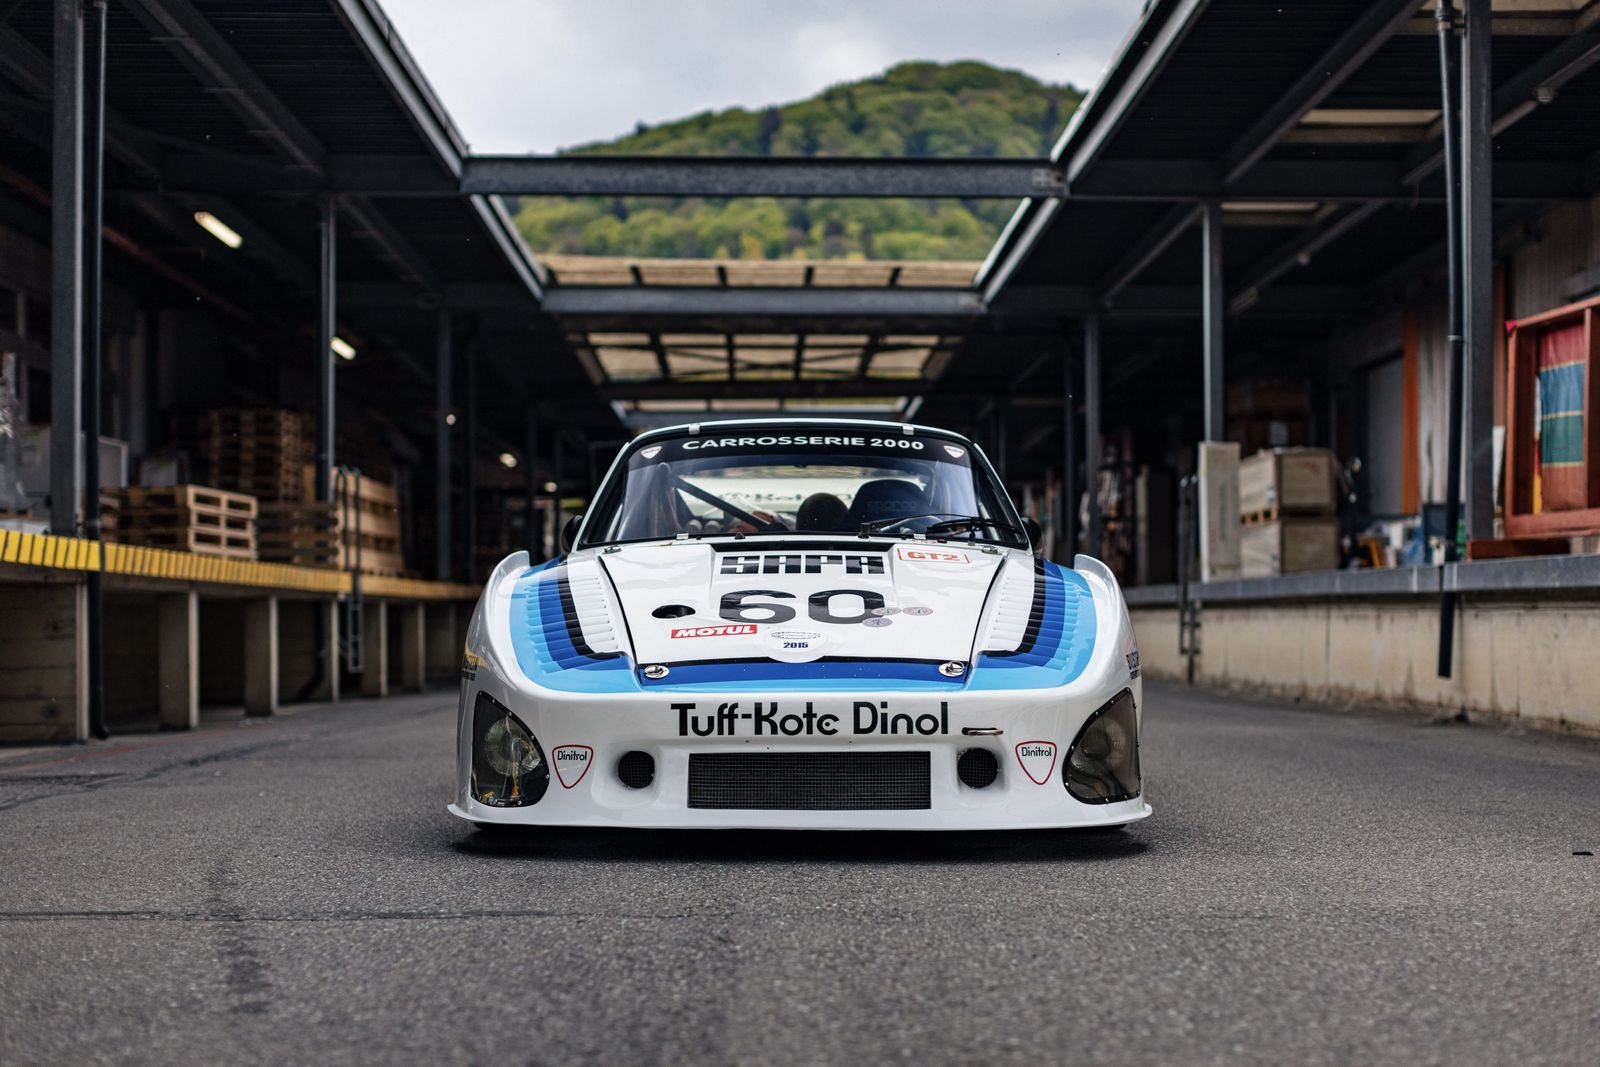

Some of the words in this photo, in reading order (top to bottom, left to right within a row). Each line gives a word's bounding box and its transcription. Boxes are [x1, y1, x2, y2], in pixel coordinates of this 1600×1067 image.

[682, 436, 865, 450] CARROSSERIE
[870, 438, 924, 451] 2000
[907, 551, 960, 561] GT2
[720, 555, 885, 574] SAPA
[719, 589, 886, 624] 60
[675, 624, 754, 637] MOTUL
[671, 702, 840, 736] Tuff-Kote
[853, 701, 948, 736] Dinol
[557, 750, 587, 761] Dinitrol
[1021, 746, 1052, 757] Dinitrol
